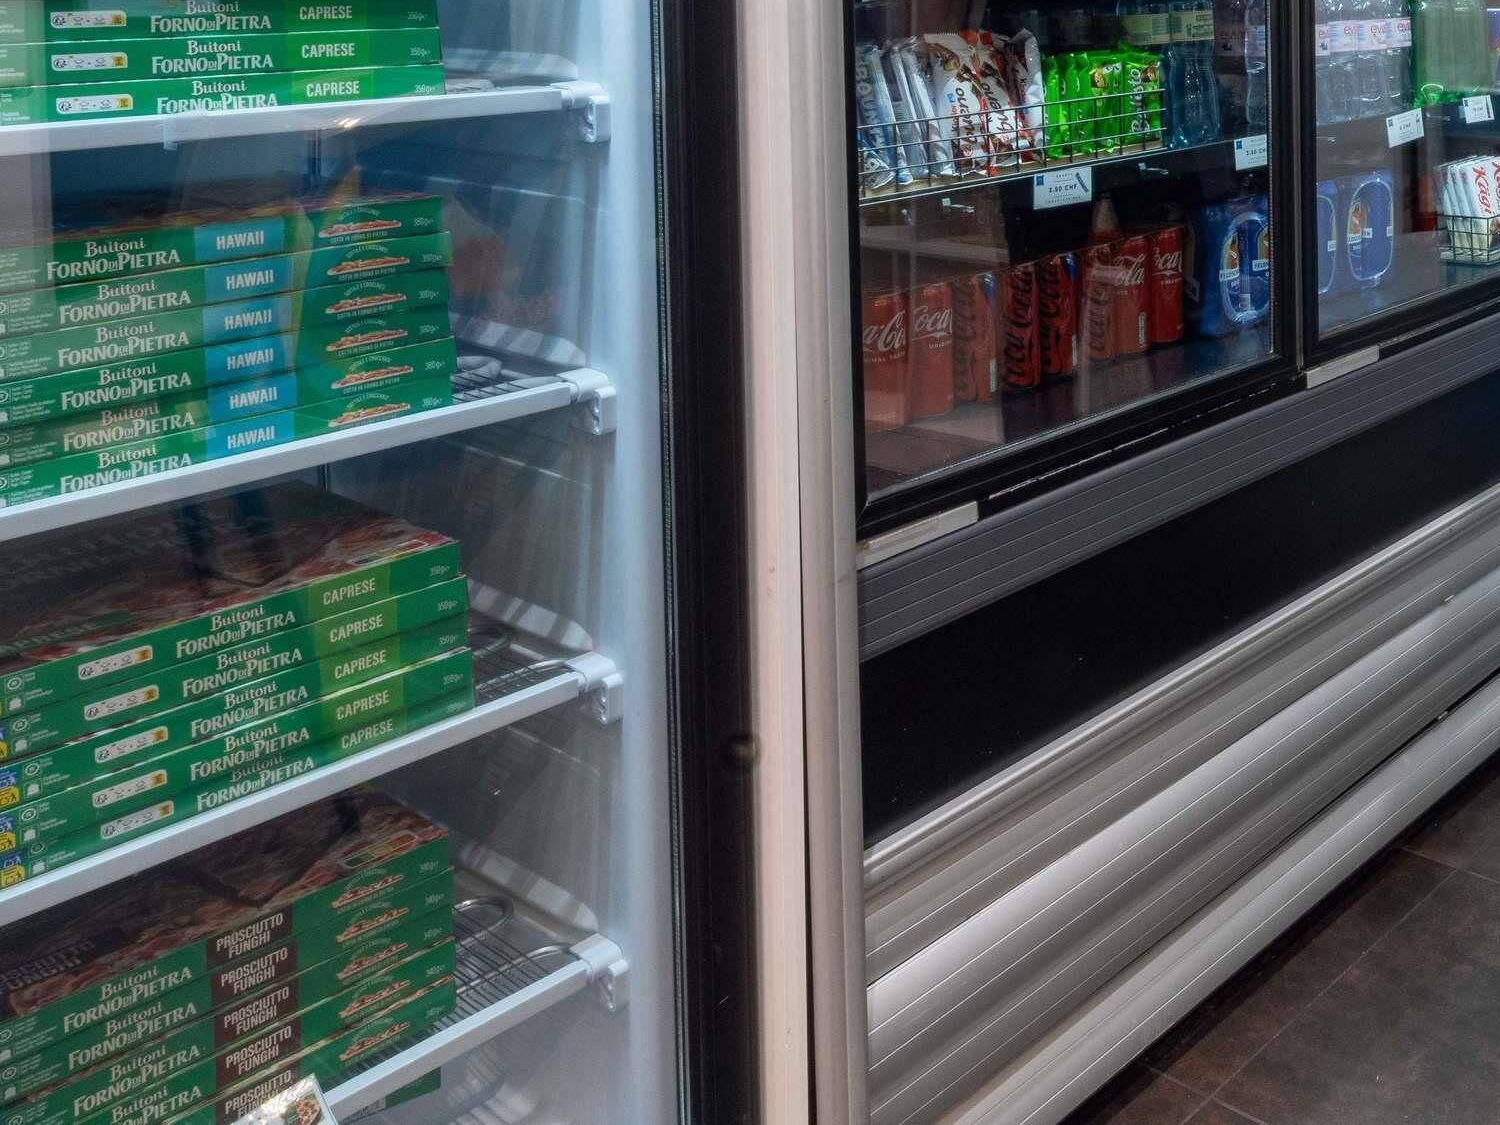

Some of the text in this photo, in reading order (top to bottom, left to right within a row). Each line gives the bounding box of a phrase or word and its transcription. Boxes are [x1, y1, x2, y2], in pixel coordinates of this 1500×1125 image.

[186, 0, 239, 14] Buitoni
[300, 6, 353, 20] CAPRESE
[186, 40, 241, 55] Buitoni
[302, 43, 355, 58] CAPRESE
[191, 81, 247, 96] Buitoni
[306, 81, 359, 97] CAPRESE
[1473, 166, 1494, 216] Kägi
[85, 237, 145, 257] Buitoni
[216, 231, 264, 250] HAWAII
[98, 280, 156, 301] Buitoni
[226, 270, 274, 290] HAWAII
[224, 309, 272, 330] HAWAII
[96, 322, 155, 344] Buitoni
[226, 348, 274, 370] HAWAII
[98, 363, 157, 385] Buitoni
[229, 387, 278, 409] HAWAII
[100, 404, 160, 427] Buitoni
[227, 426, 275, 450] HAWAII
[97, 445, 157, 469] Buitoni
[323, 579, 376, 604] CAPRESE
[210, 604, 265, 630] Buitoni
[330, 615, 383, 642] CAPRESE
[216, 643, 271, 669] Buitoni
[334, 650, 387, 678] CAPRESE
[223, 680, 278, 708] Buitoni
[336, 691, 390, 720] CAPRESE
[225, 723, 278, 752] Buitoni
[341, 719, 393, 748] CAPRESE
[216, 913, 283, 951] PROSCIUTTO
[228, 932, 271, 959] FUNGHI
[221, 948, 288, 987] PROSCIUTTO
[233, 967, 275, 994] FUNGHI
[100, 965, 160, 1000] Buitoni
[105, 1002, 162, 1037] Buitoni
[223, 986, 290, 1027] PROSCIUTTO
[236, 1007, 278, 1034] FUNGHI
[226, 1026, 292, 1067] PROSCIUTTO
[109, 1045, 167, 1082] Buitoni
[238, 1045, 280, 1075] FUNGHI
[111, 1091, 168, 1125] Buitoni
